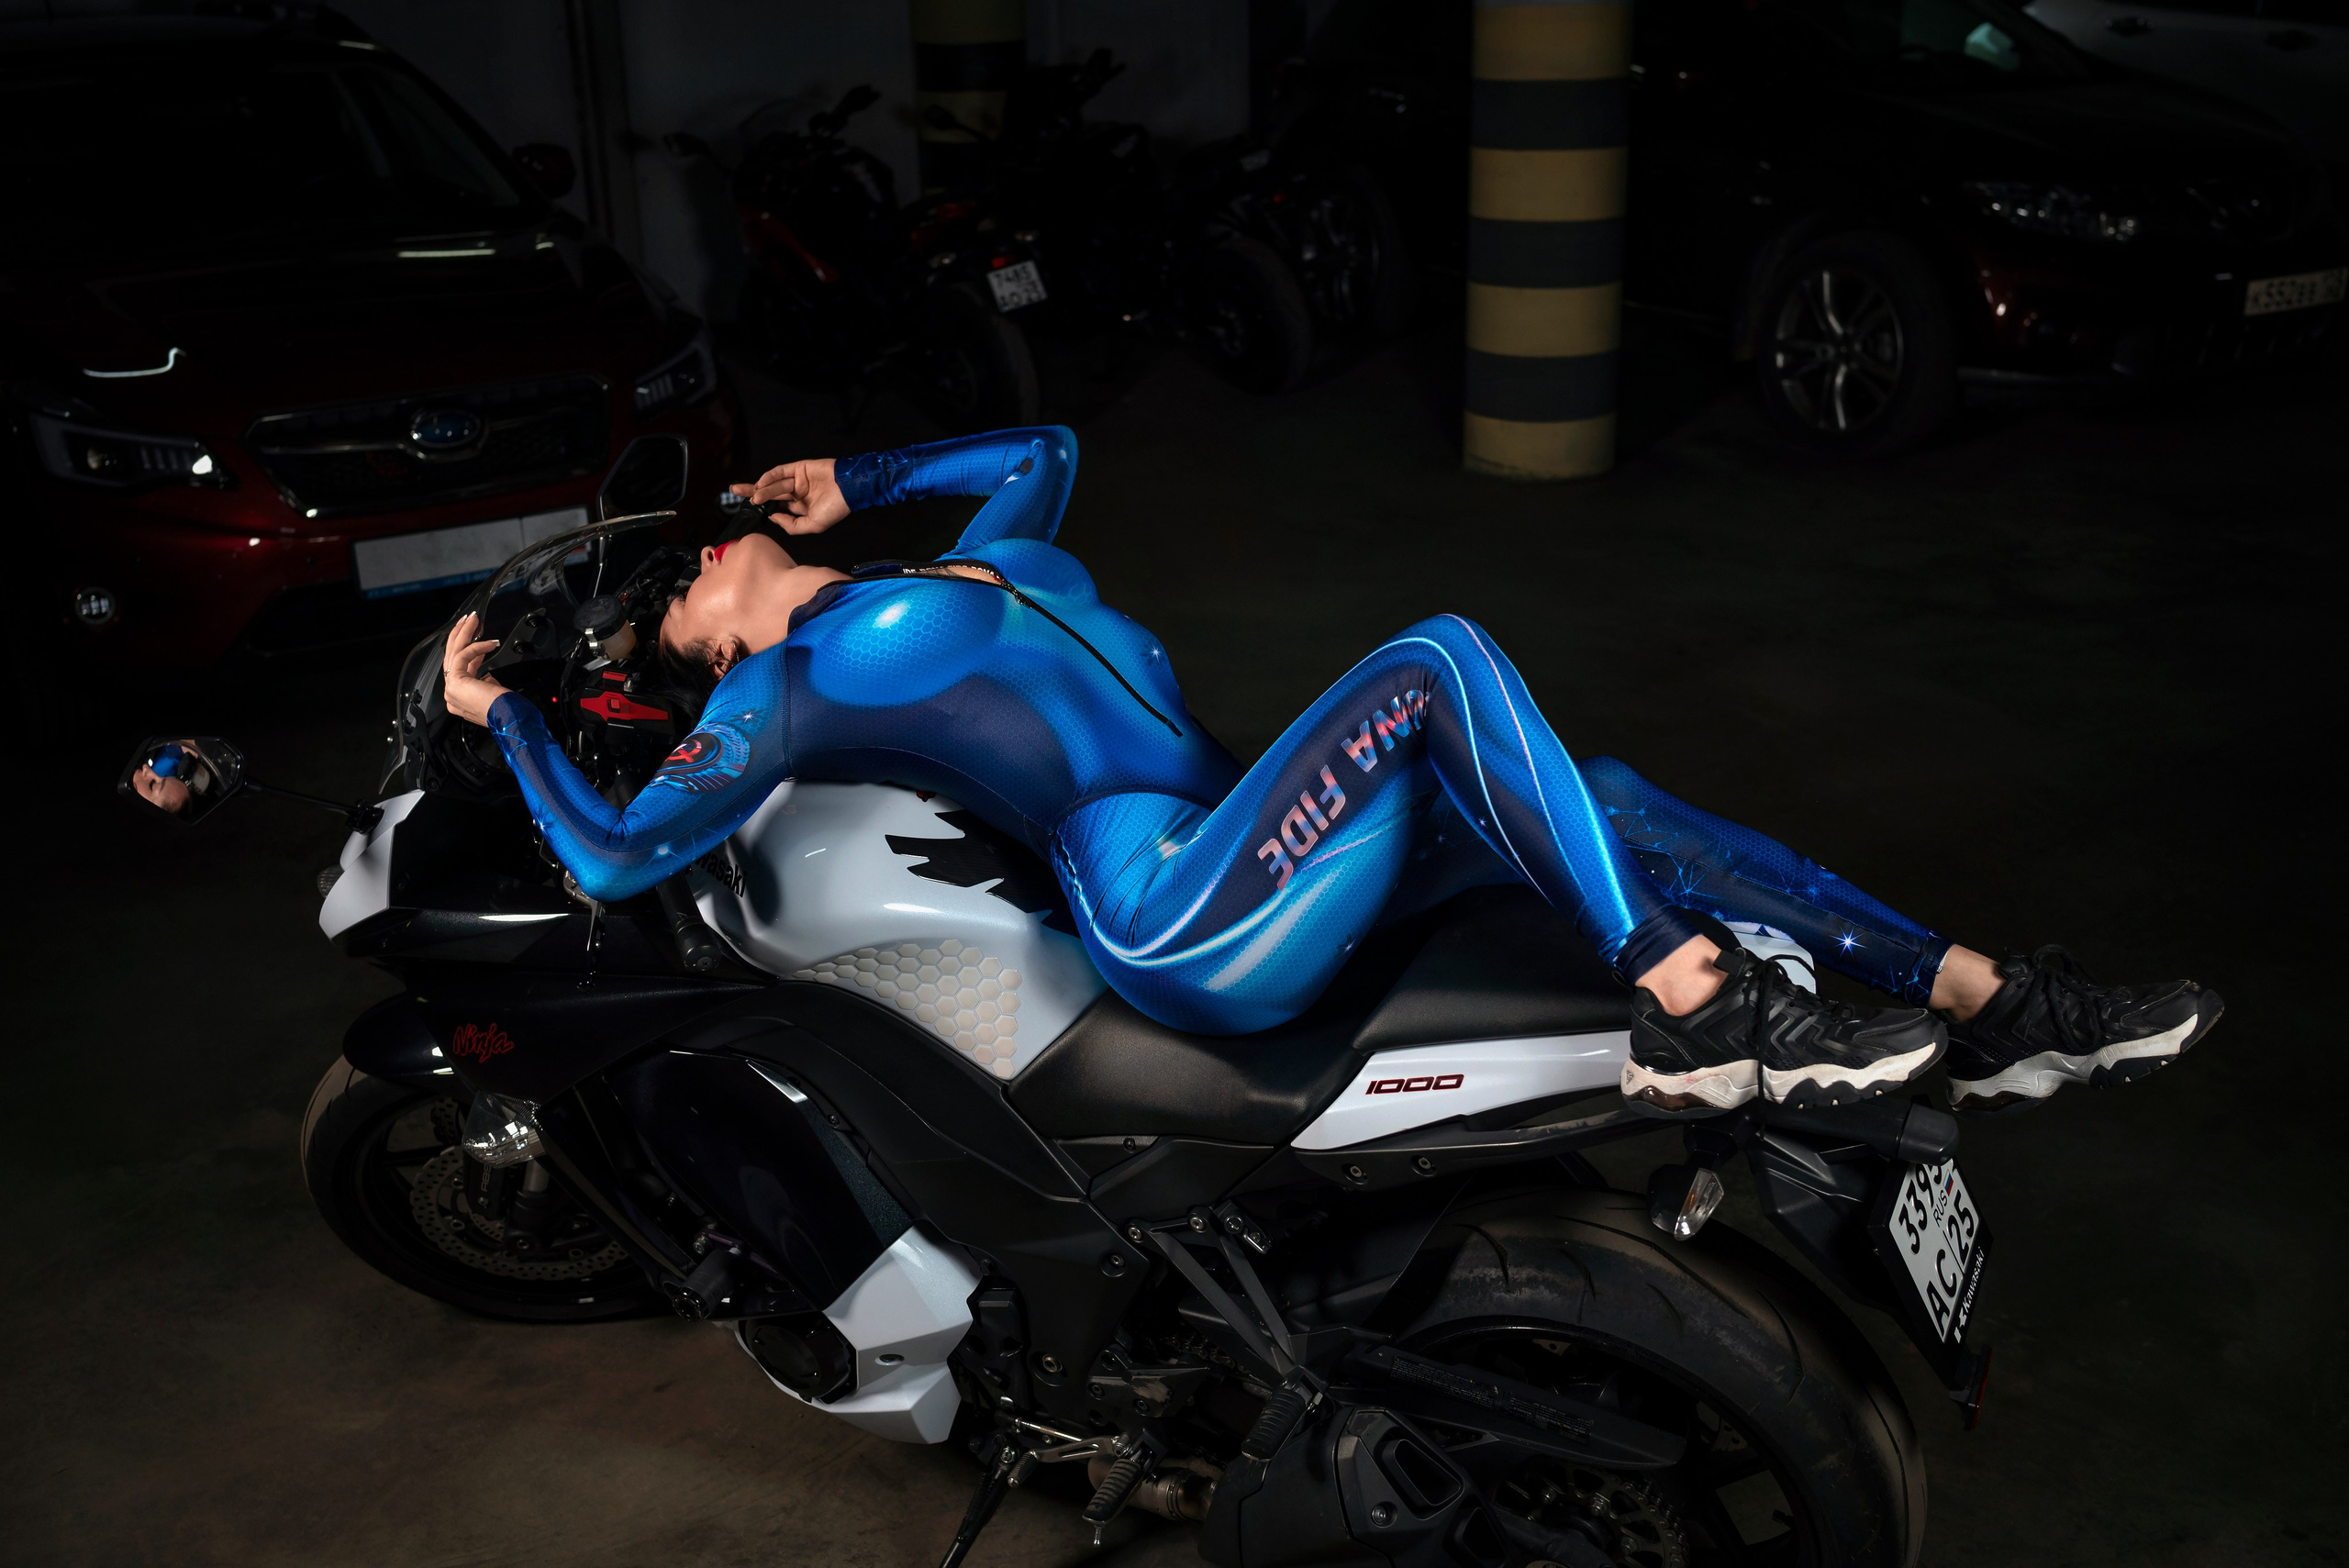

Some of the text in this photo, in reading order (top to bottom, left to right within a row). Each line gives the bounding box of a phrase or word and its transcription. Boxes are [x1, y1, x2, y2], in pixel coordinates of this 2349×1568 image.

[1257, 689, 1432, 892] ONA FIDE
[693, 851, 748, 898] wasaki
[452, 1022, 515, 1064] Ninja
[1365, 1073, 1464, 1095] 1000
[1932, 1189, 1948, 1228] RUS
[1947, 1189, 1975, 1266] 25
[1926, 1249, 1957, 1337] AC
[1963, 1246, 1985, 1314] Kawasaki
